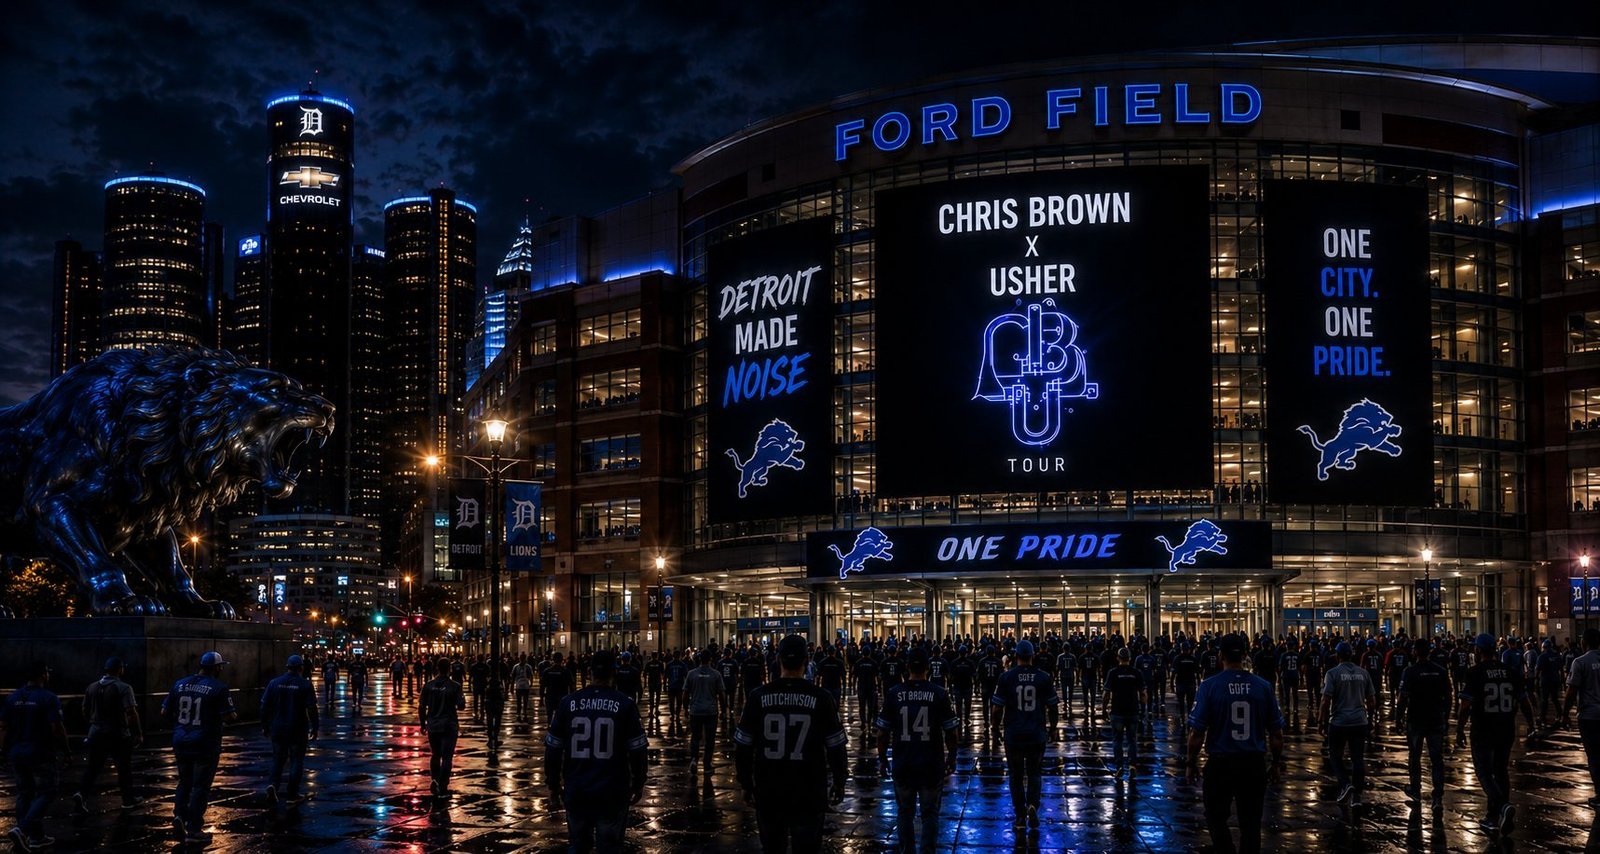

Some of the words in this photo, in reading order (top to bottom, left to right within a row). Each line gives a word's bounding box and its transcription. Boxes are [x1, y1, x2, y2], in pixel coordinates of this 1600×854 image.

[836, 97, 1011, 161] FORD
[1047, 83, 1263, 129] FIELD
[279, 194, 341, 207] CHEVROLET
[938, 197, 1019, 235] CHRIS
[1029, 192, 1131, 228] BROWN
[1025, 235, 1039, 258] X
[1323, 227, 1372, 259] ONE
[719, 265, 822, 321] DETROIT
[990, 264, 1077, 297] USHER
[1321, 266, 1379, 298] CITY.
[735, 314, 799, 355] MADE
[1325, 306, 1374, 338] ONE
[1313, 345, 1391, 377] PRIDE.
[723, 352, 811, 408] NOISE
[1007, 457, 1066, 473] TOUR
[451, 543, 483, 555] DETROIT
[509, 545, 538, 556] LIONS
[937, 535, 1005, 562] ONE
[1015, 533, 1122, 561] PRIDE
[760, 693, 817, 709] HUTCHINSON
[897, 691, 907, 702] ST
[908, 690, 935, 703] BROWN
[1015, 684, 1037, 712] 19
[1228, 682, 1252, 695] GOFF
[1484, 682, 1514, 713] 26
[177, 695, 202, 726] 81
[570, 699, 579, 713] B.
[579, 698, 620, 713] SANDERS
[1231, 700, 1251, 741] 9
[571, 716, 615, 760] 20
[763, 712, 812, 761] 97
[899, 705, 931, 742] 14
